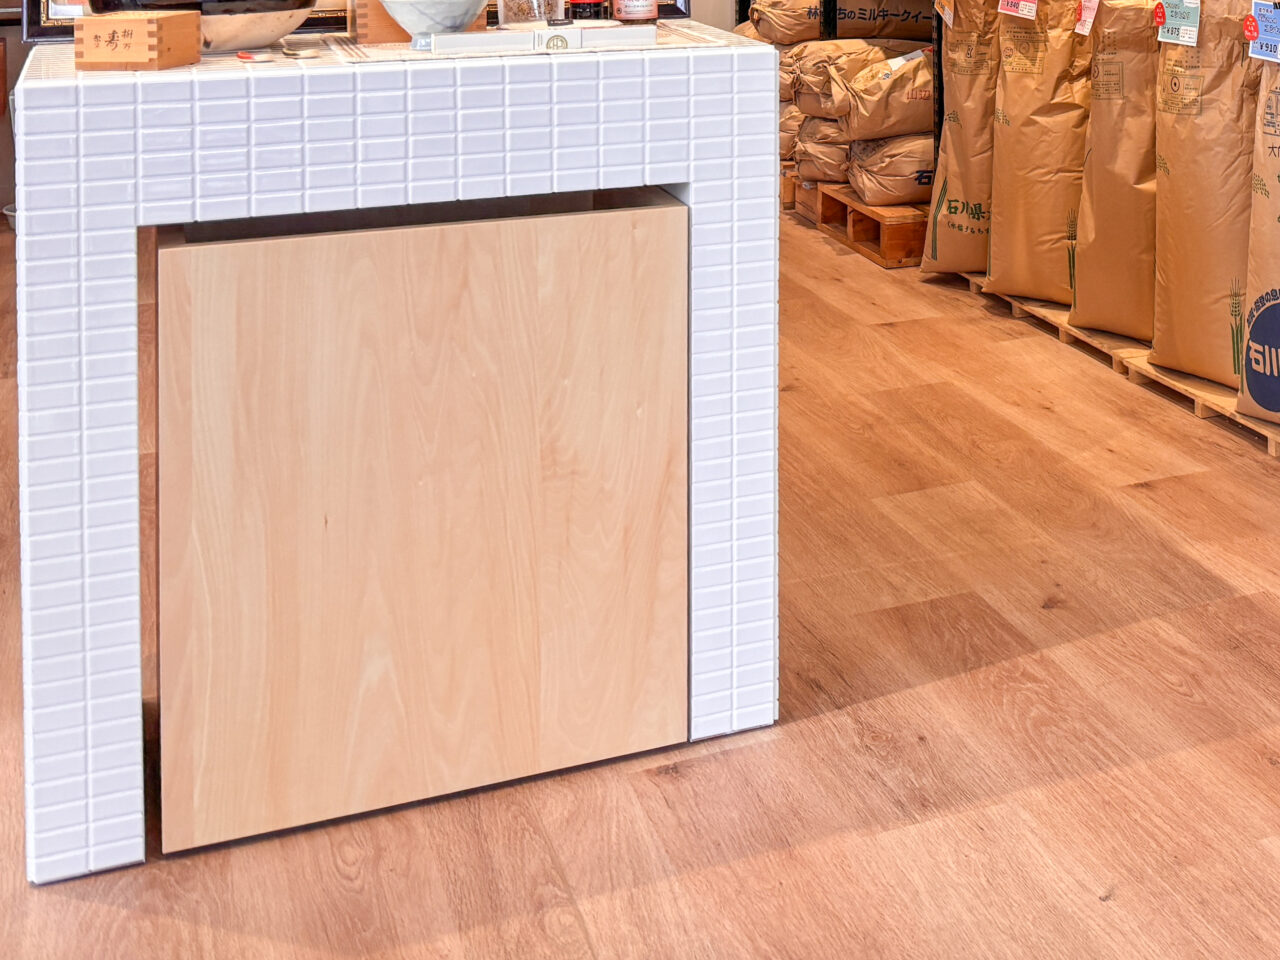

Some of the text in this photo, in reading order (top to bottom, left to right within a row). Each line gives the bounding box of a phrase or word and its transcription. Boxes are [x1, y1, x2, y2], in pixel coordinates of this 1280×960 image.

[806, 5, 933, 24] 林ちのミルキークイー
[1260, 42, 1278, 53] ￥910
